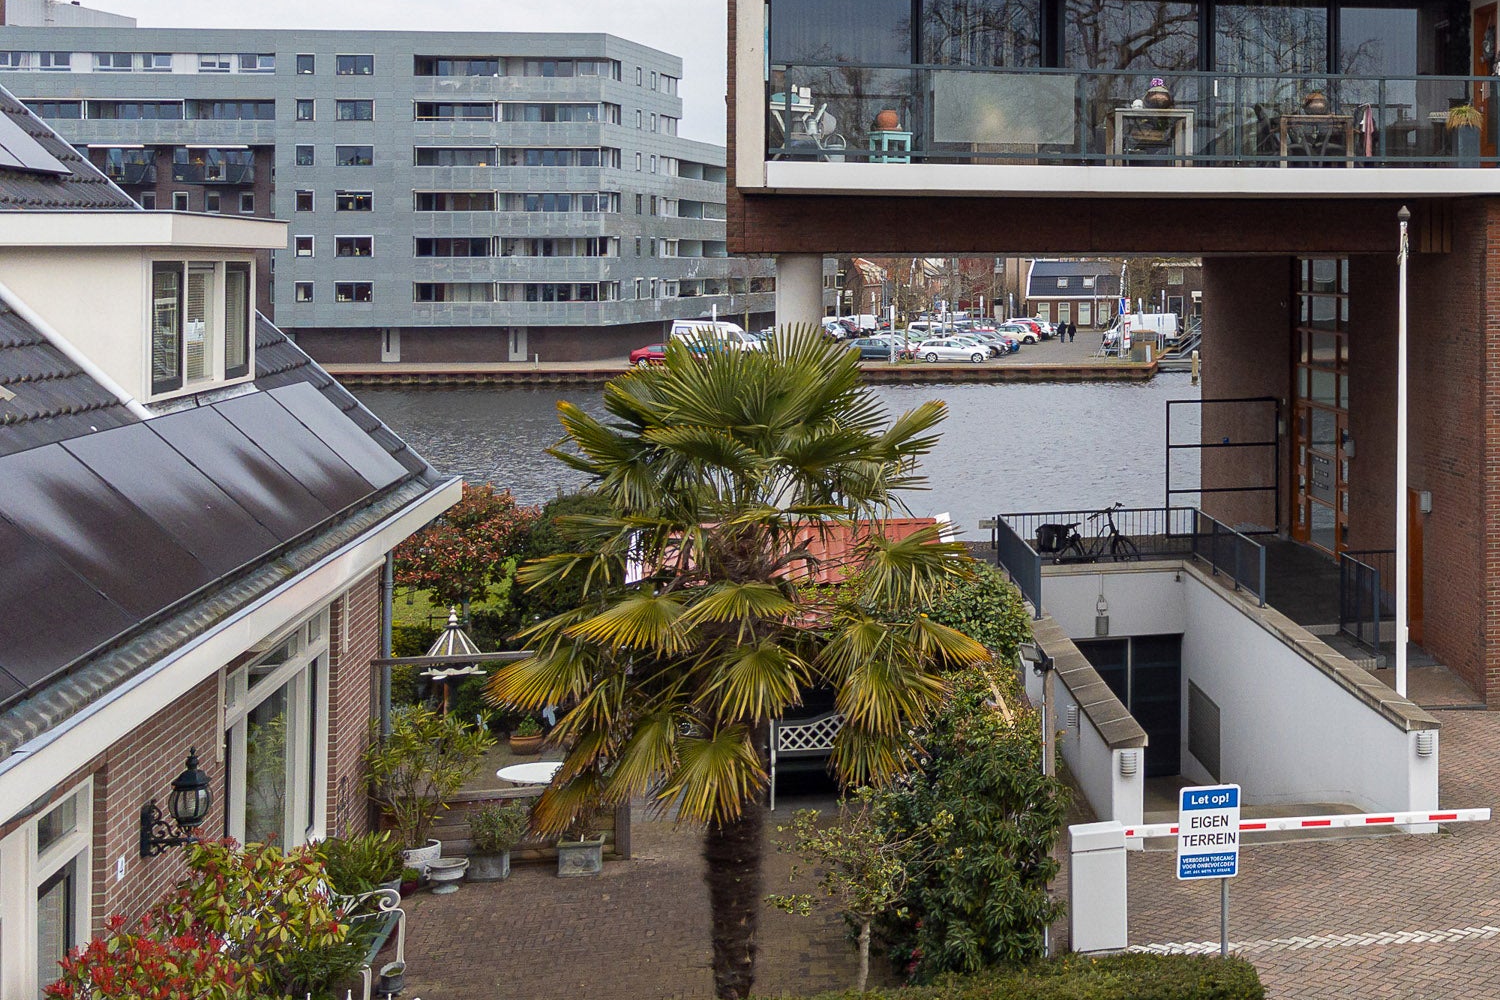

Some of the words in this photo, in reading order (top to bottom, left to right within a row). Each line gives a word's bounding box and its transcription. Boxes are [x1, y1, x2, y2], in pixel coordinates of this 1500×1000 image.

[1191, 795, 1209, 805] Let
[1211, 792, 1229, 806] op!
[1191, 815, 1229, 829] EIGEN
[1182, 832, 1236, 847] TERREIN
[1182, 856, 1210, 864] VERBODEN
